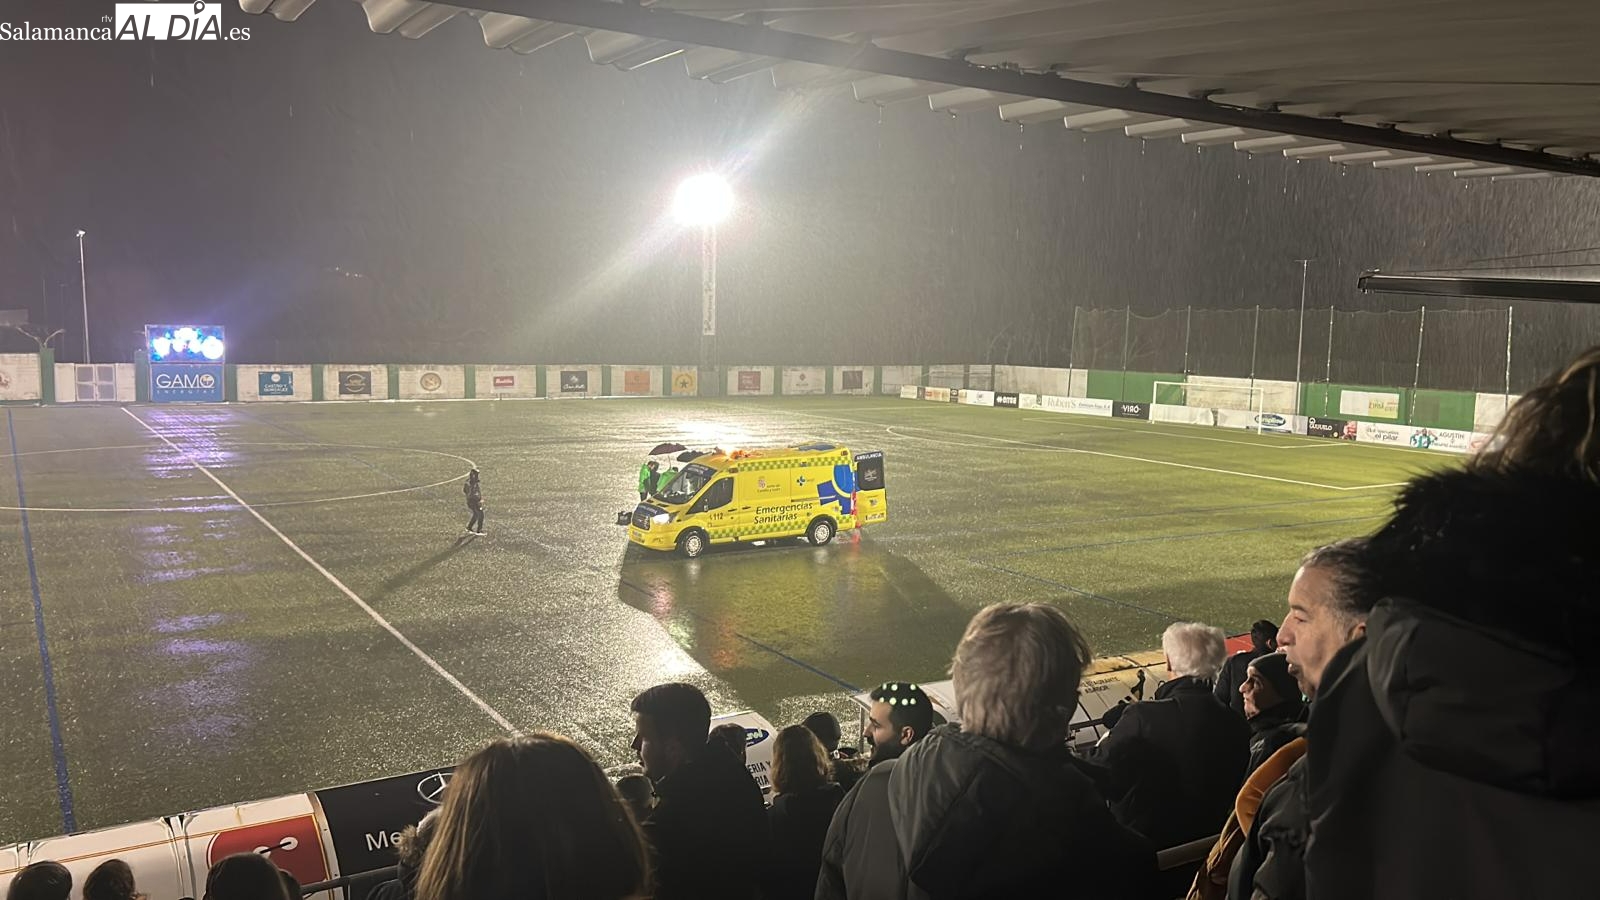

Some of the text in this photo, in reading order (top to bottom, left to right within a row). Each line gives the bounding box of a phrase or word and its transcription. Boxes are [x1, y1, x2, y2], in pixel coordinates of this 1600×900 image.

[156, 373, 215, 388] GAMO
[756, 501, 813, 515] Emergencias
[712, 512, 724, 520] 112
[754, 512, 798, 525] Sanitarias
